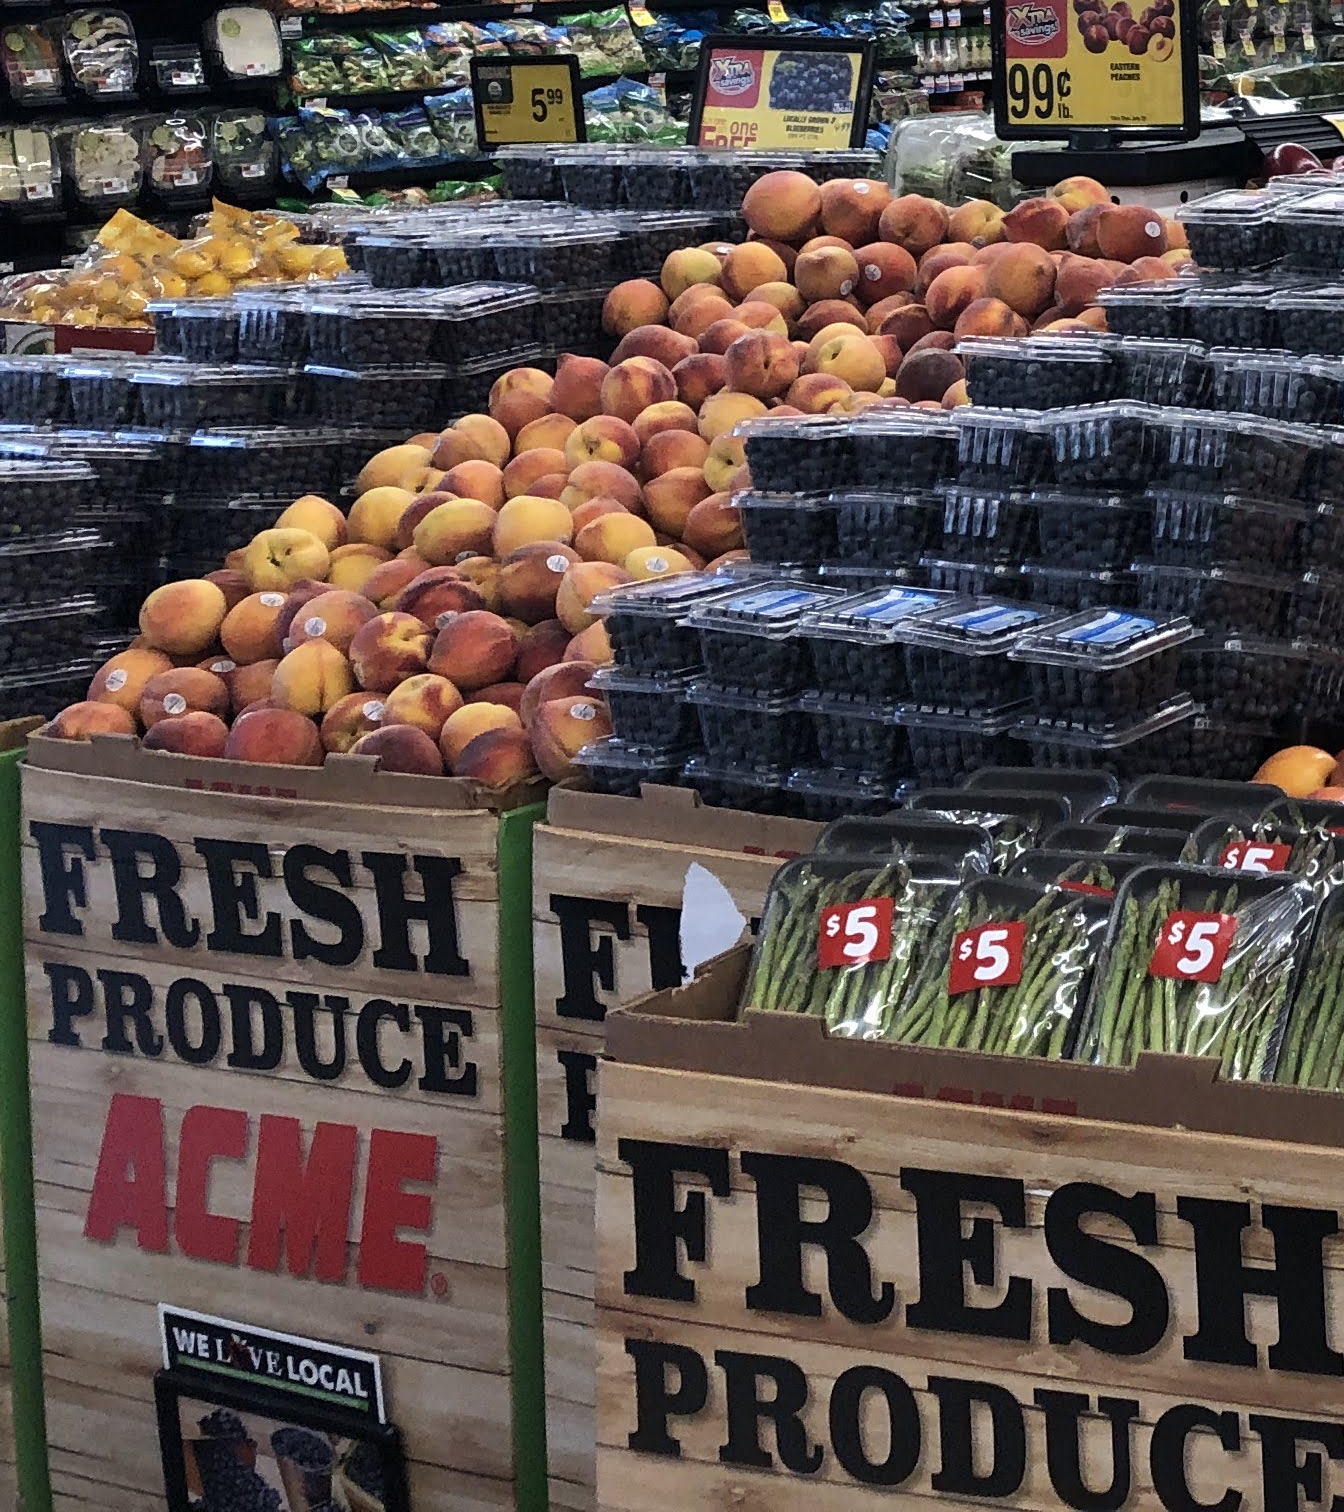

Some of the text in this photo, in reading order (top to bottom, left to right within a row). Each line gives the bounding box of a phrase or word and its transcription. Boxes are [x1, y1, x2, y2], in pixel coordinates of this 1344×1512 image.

[1110, 63, 1140, 71] EASTERN
[1110, 73, 1141, 81] PEACHES
[730, 120, 759, 137] one
[29, 820, 470, 976] FRESH
[826, 905, 880, 959] $5
[958, 928, 1010, 983] $5
[1167, 919, 1217, 975] $5
[44, 962, 477, 1096] PRODUCE
[84, 1093, 439, 1291] ACME
[618, 1139, 1344, 1378] FRESH
[172, 1326, 209, 1358] WE
[286, 1354, 368, 1398] LOCAL
